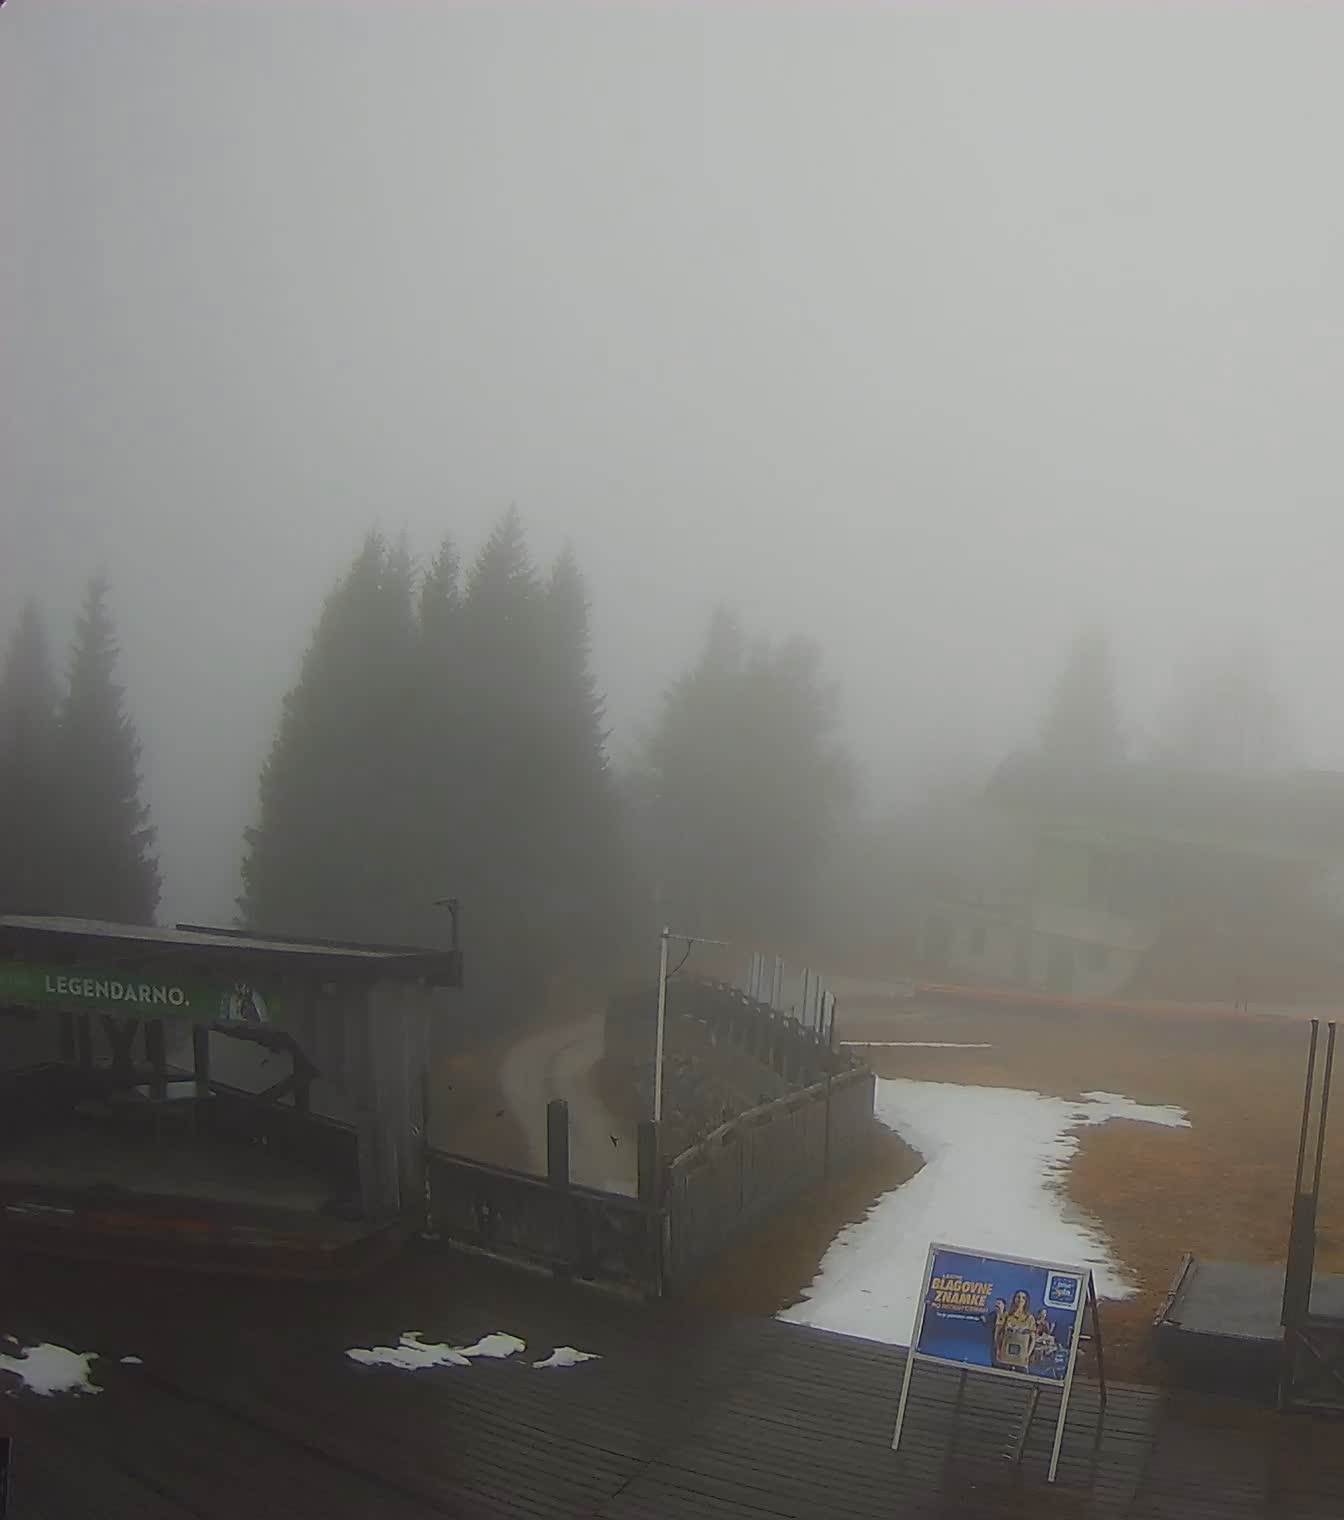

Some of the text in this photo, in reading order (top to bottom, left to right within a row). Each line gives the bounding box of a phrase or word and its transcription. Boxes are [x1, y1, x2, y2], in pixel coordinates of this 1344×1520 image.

[45, 975, 190, 1006] LEGENDARNO.
[931, 1277, 993, 1296] BLAGOVNE
[934, 1290, 986, 1306] ZNAMKE
